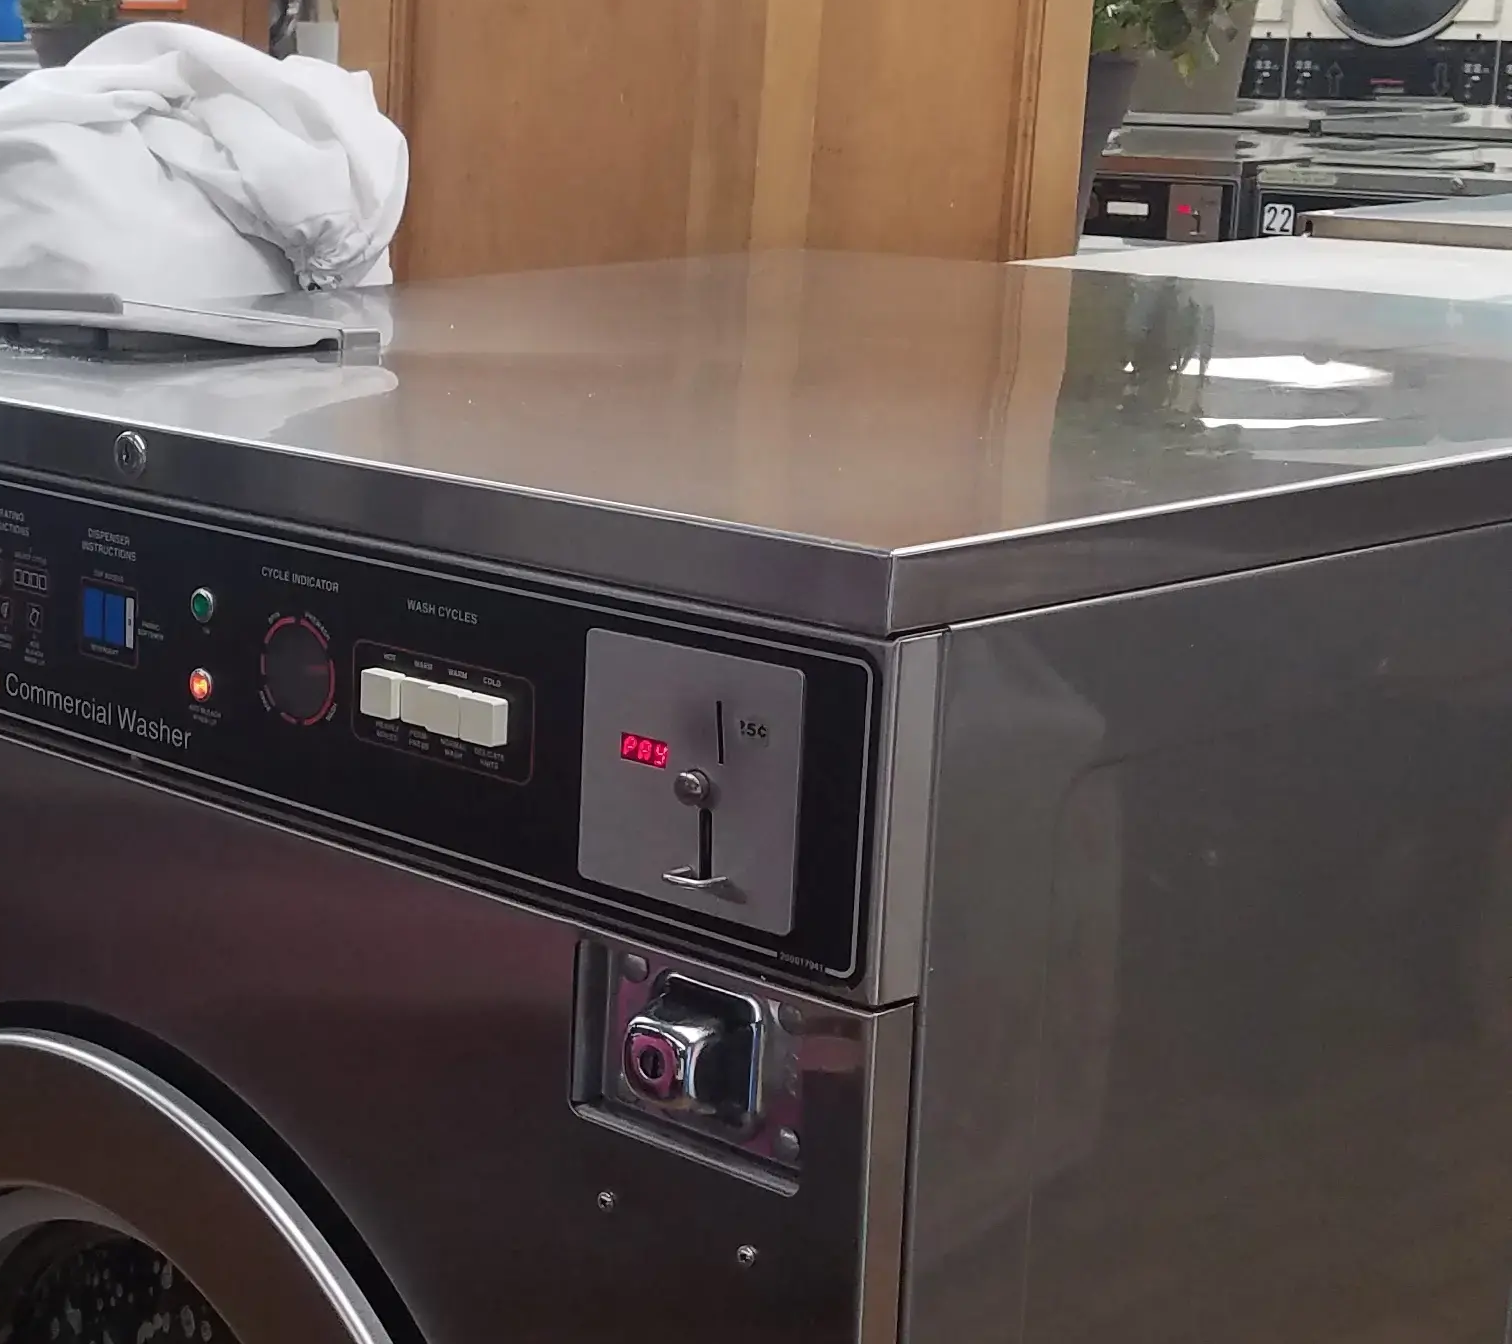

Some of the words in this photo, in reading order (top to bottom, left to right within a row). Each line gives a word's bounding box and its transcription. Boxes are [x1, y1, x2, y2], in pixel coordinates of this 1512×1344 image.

[1266, 206, 1292, 233] 22
[88, 527, 131, 546] DISPENSER
[81, 541, 137, 562] INSTRUCTIONS
[261, 566, 290, 583] CYCLE
[292, 572, 340, 594] INDICATOR
[407, 598, 436, 616] WASH
[437, 605, 479, 625] CYCLES
[482, 676, 502, 688] COLD
[5, 672, 112, 726] Commercial
[118, 707, 192, 750] Washer
[622, 734, 669, 767] PAY
